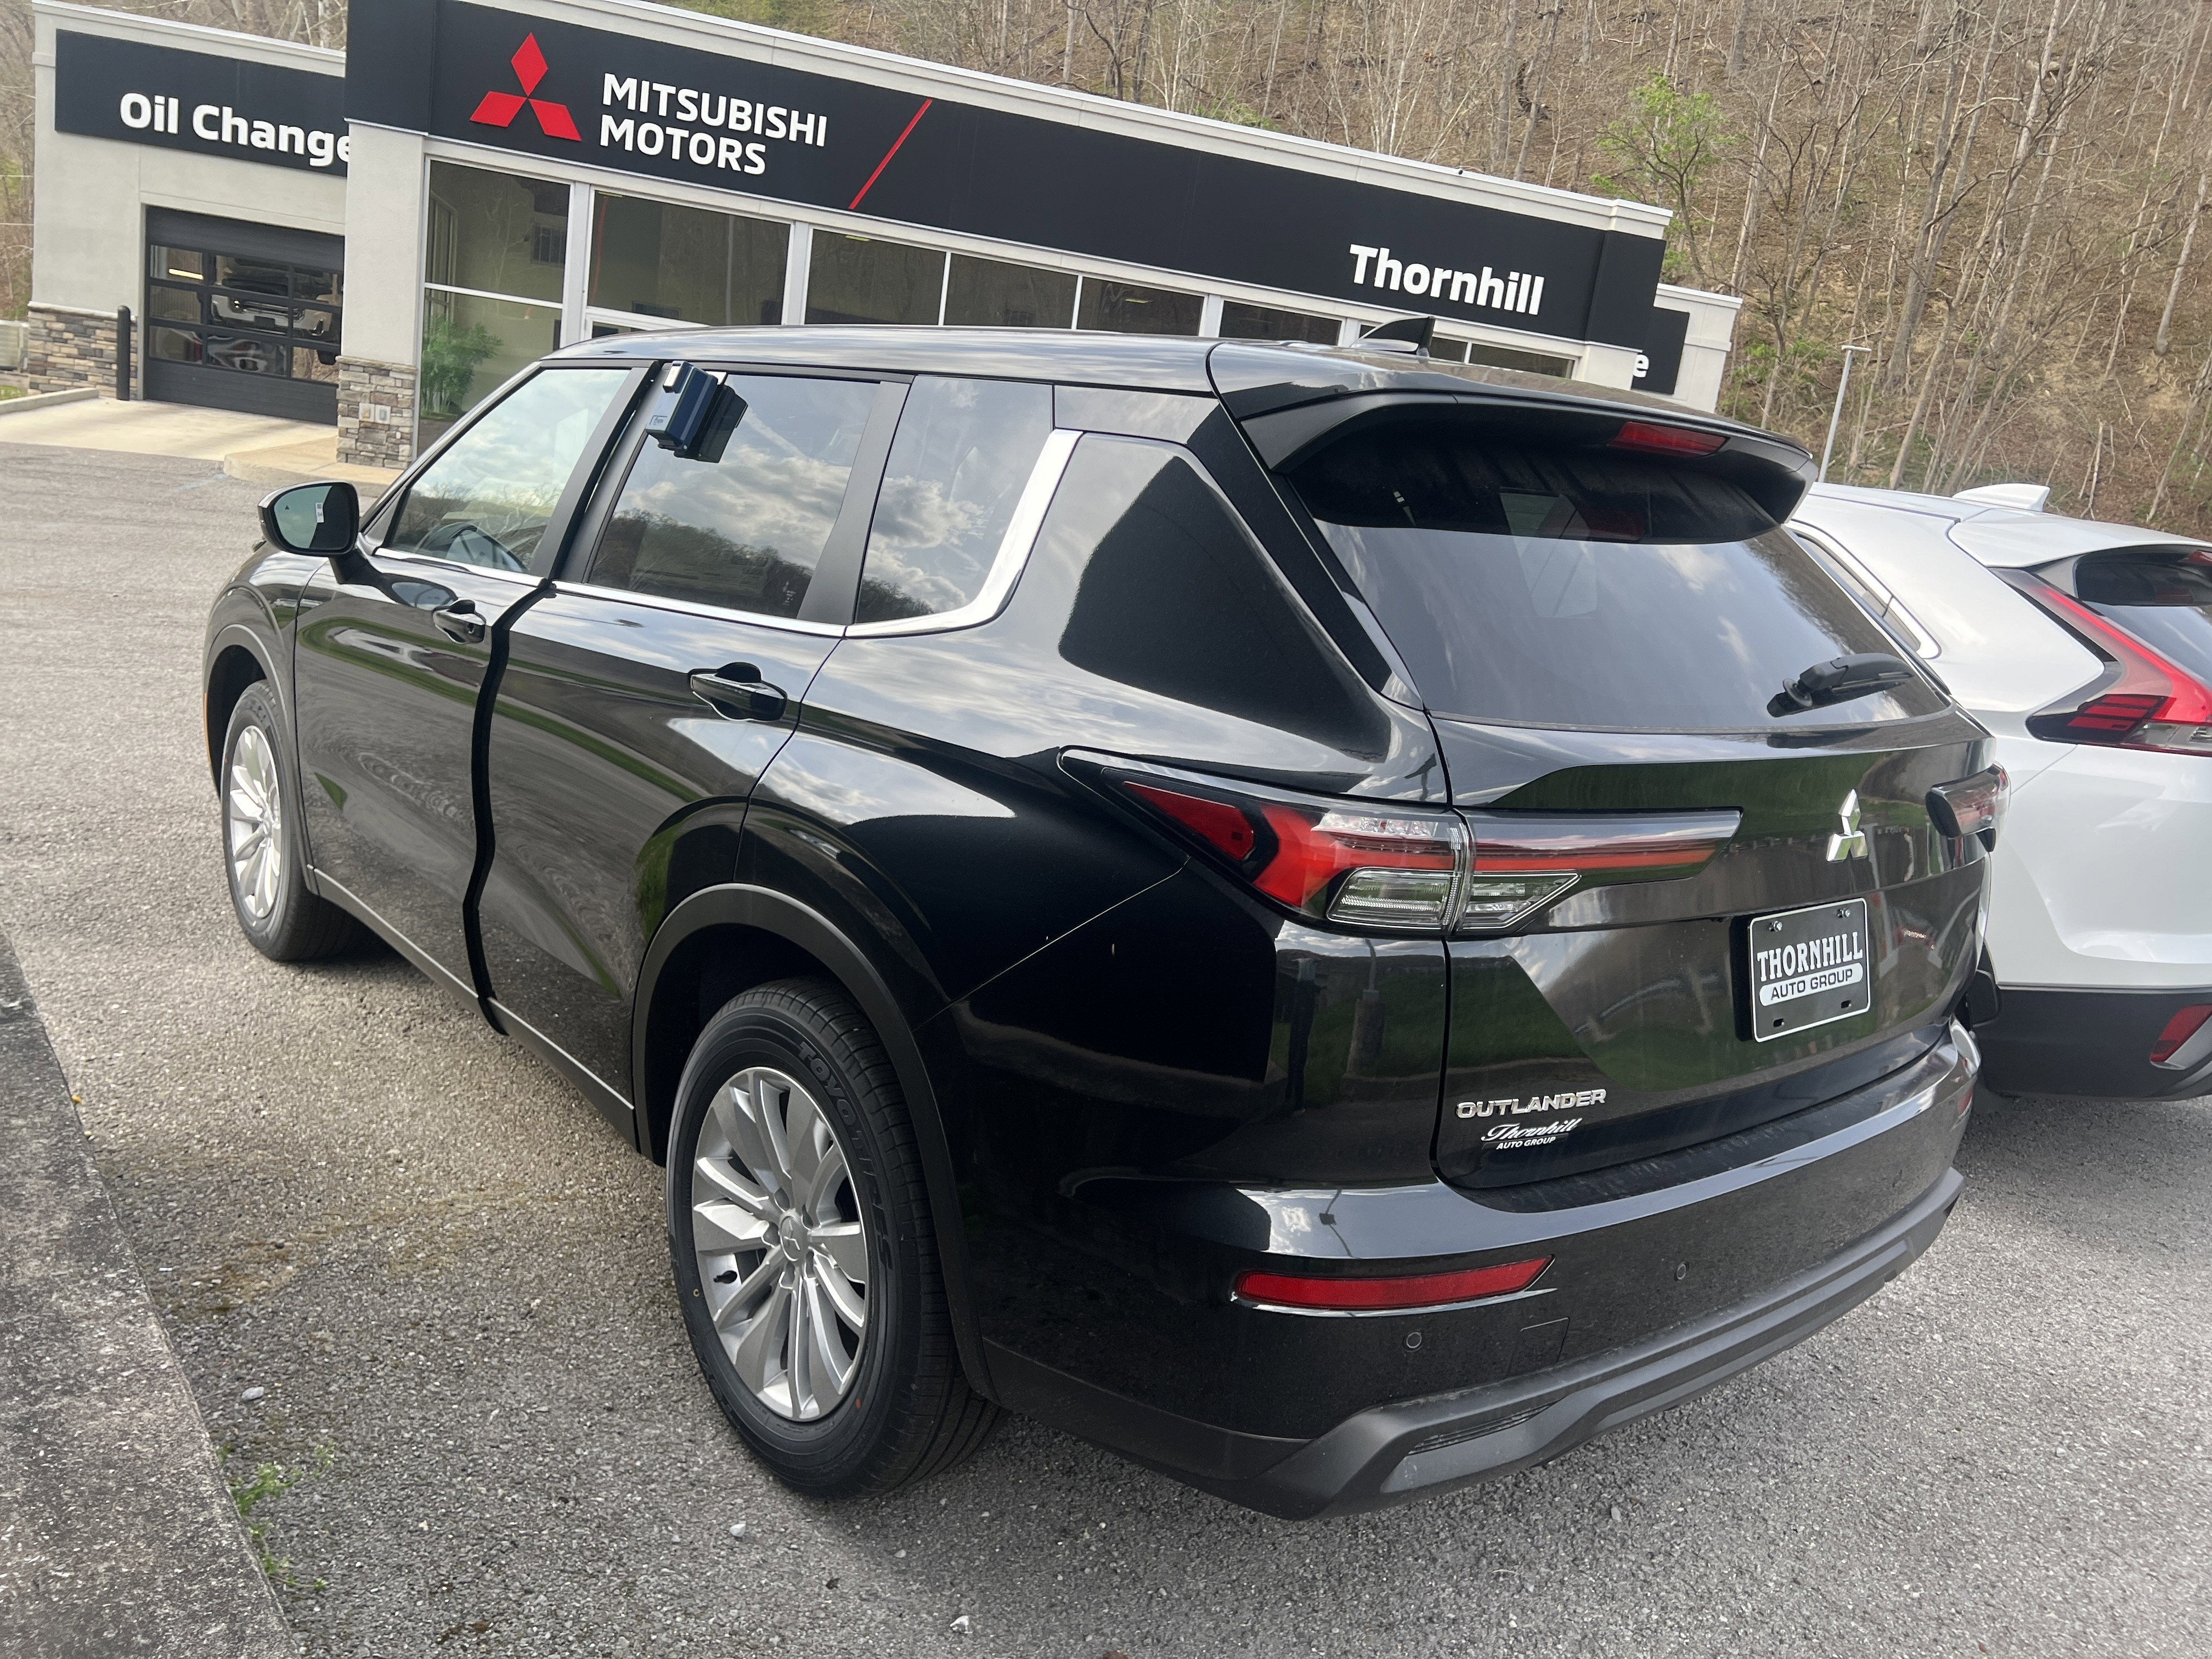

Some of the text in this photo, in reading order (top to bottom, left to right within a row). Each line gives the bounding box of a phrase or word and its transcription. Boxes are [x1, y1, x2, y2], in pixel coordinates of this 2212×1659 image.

[120, 93, 179, 134] Oil
[602, 73, 827, 147] MITSUBISHI
[600, 114, 767, 176] MOTORS
[1350, 244, 1545, 315] Thornhill
[1757, 932, 1863, 981] THORNHILL
[1771, 968, 1853, 1000] AUTO GROUP
[799, 1042, 856, 1126] TOYO
[1456, 1088, 1606, 1119] OUTLANDER
[1481, 1118, 1582, 1141] Thornhill
[1496, 1136, 1556, 1150] AUTO GROUP
